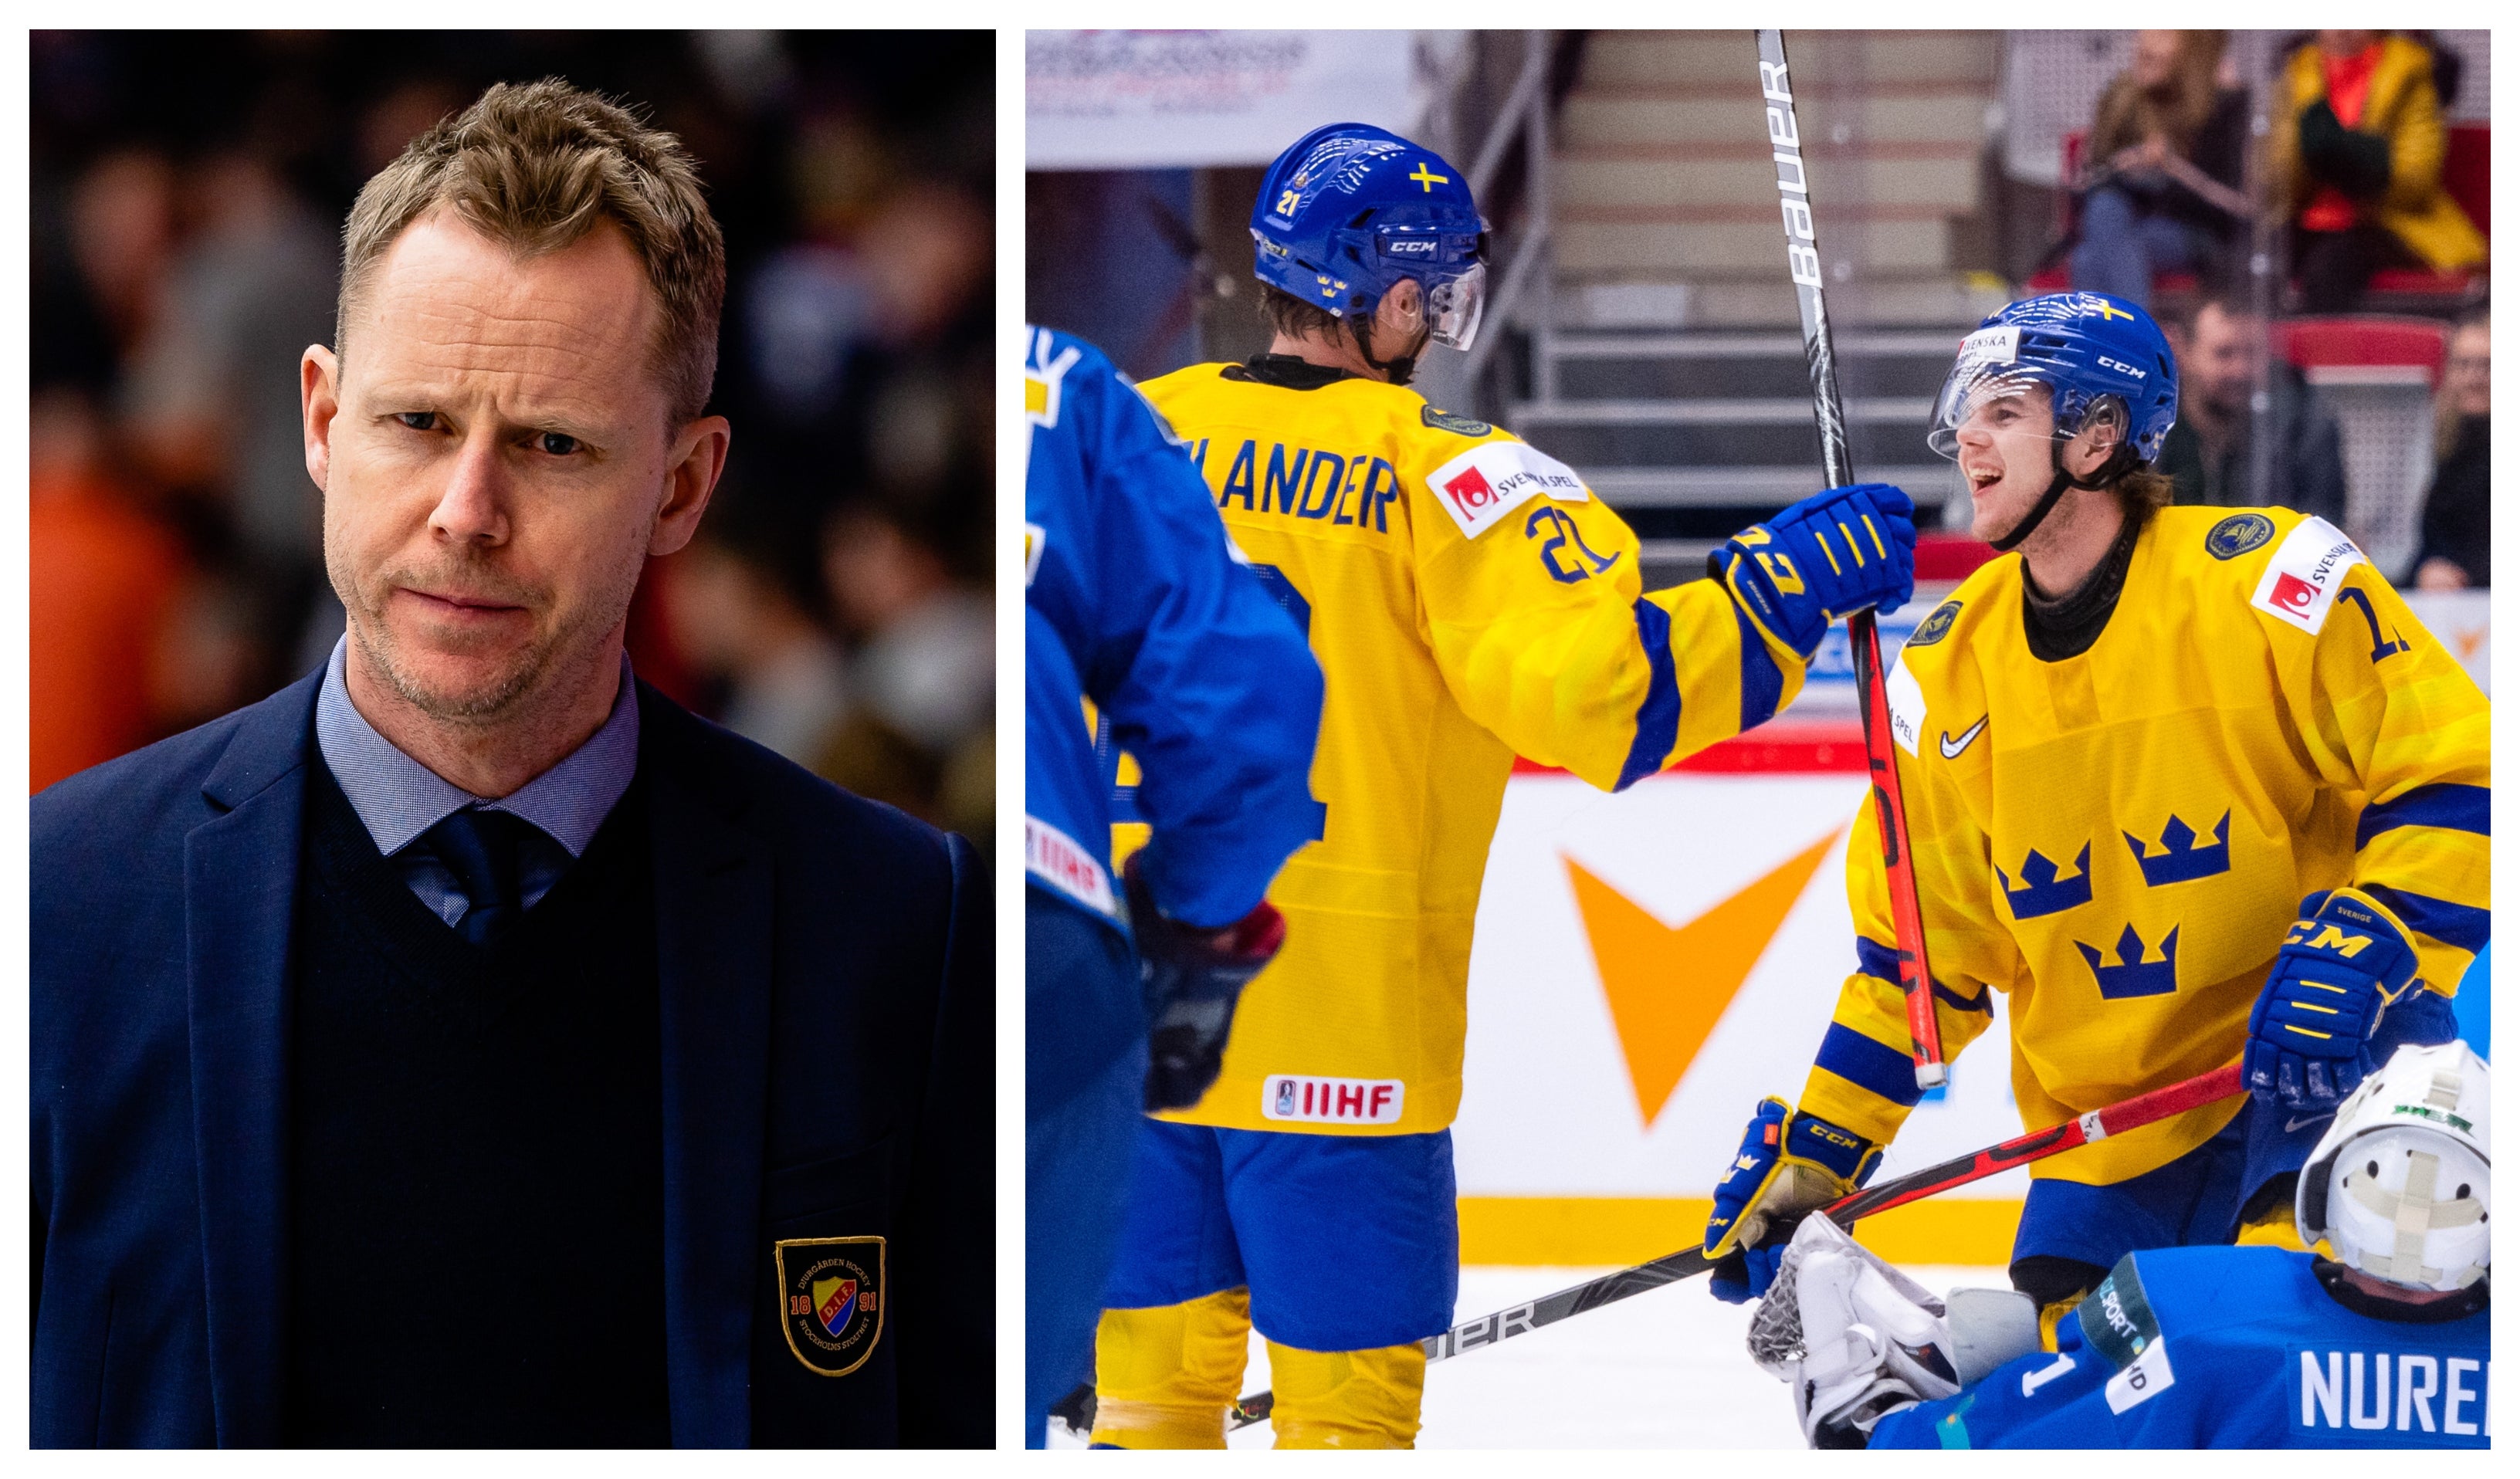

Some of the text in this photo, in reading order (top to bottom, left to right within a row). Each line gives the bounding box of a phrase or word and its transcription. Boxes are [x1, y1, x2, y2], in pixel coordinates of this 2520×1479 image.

[1276, 190, 1300, 216] 21
[1390, 242, 1437, 252] CCM
[2097, 356, 2146, 379] CCM
[1184, 438, 1397, 534] ANDER
[1524, 506, 1621, 584] 21
[2338, 906, 2372, 923] SVERIGE
[2281, 920, 2373, 958] CM
[1303, 1082, 1393, 1118] IIHF
[1810, 1124, 1858, 1149] CCM
[798, 1259, 871, 1290] DJURGÅRDEN HOCKEY
[791, 1292, 876, 1315] 18 91
[800, 1317, 869, 1350] STOCKHOLMS STOLTHET
[2022, 1353, 2076, 1398] 1
[2300, 1350, 2491, 1437] NURE
